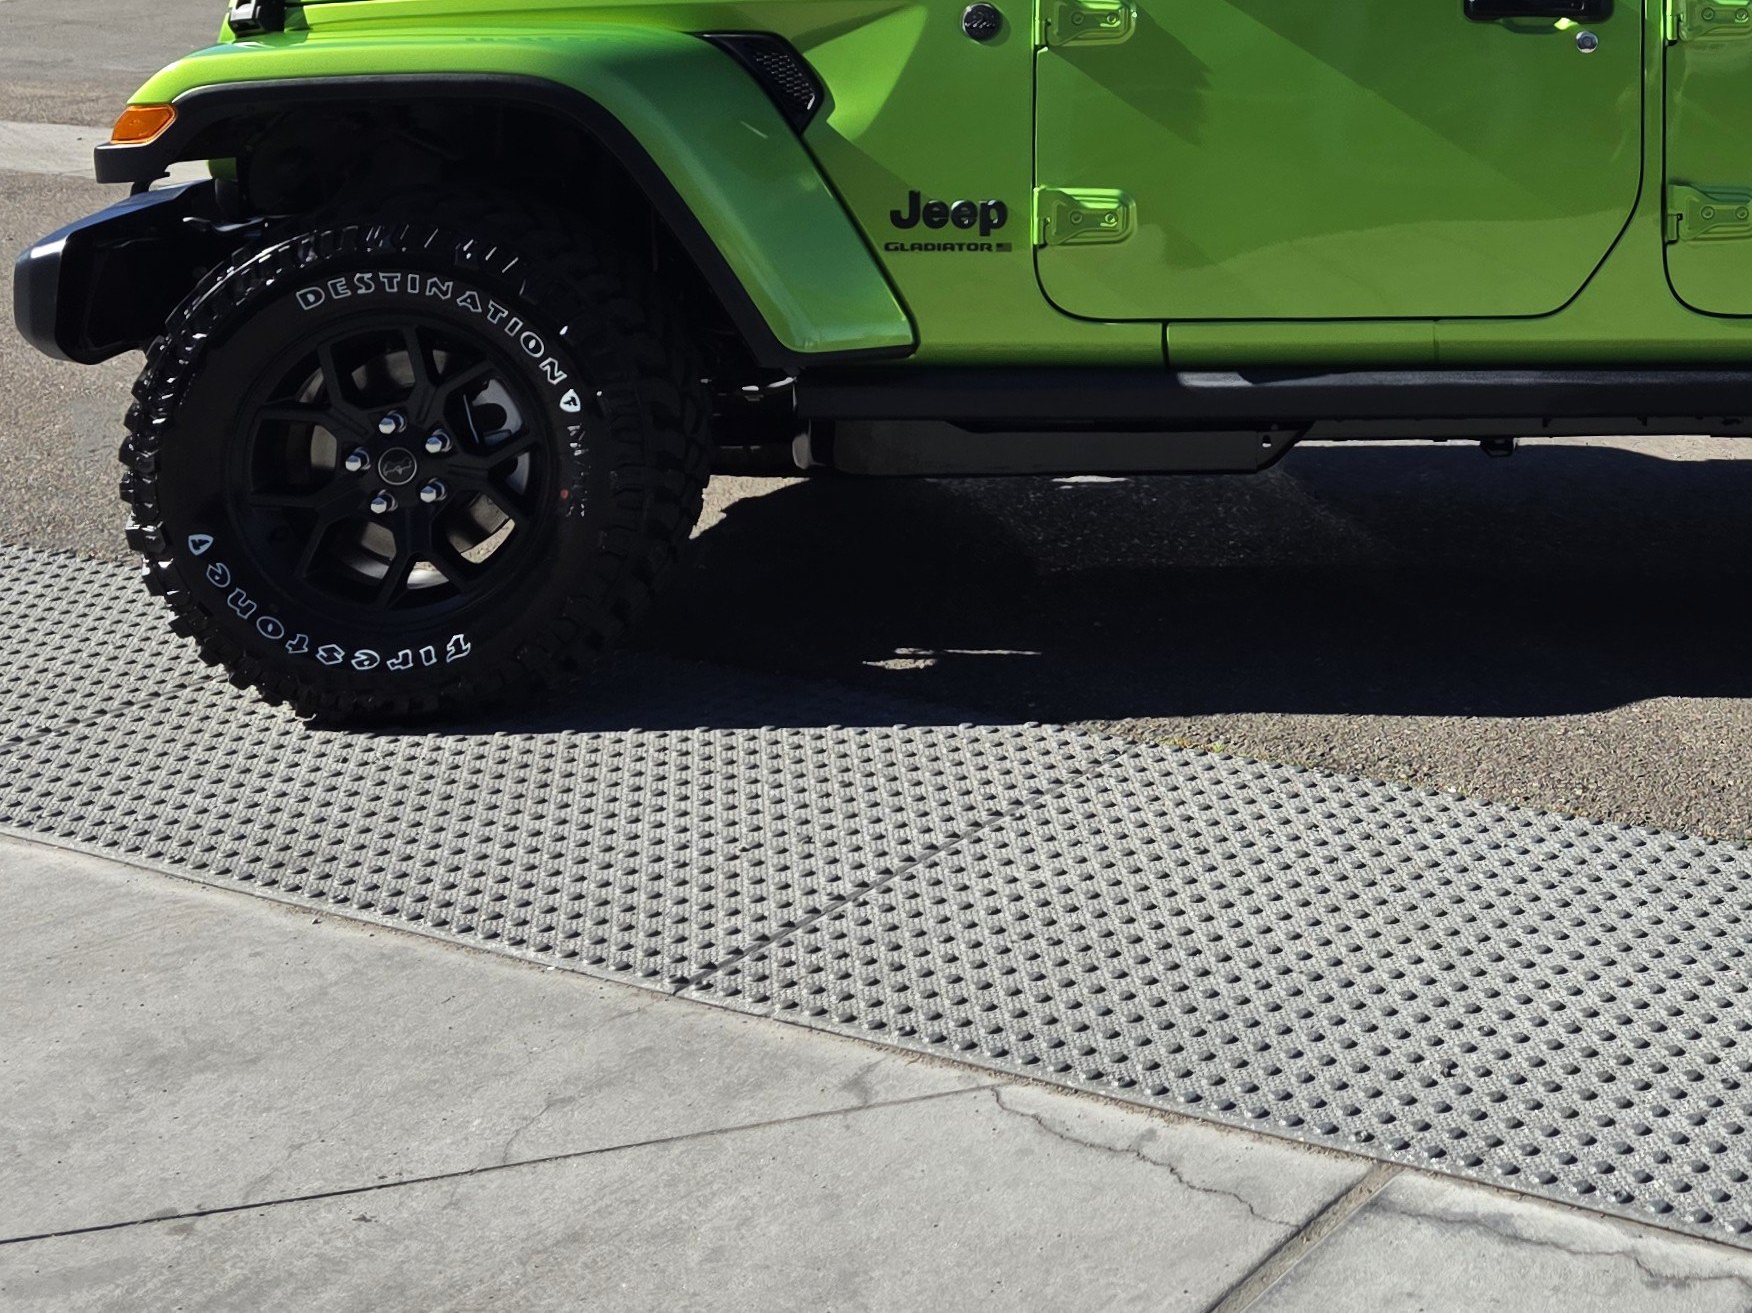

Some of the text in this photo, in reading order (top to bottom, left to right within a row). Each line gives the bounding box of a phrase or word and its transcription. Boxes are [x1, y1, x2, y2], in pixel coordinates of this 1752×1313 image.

[890, 190, 1008, 236] Jeep
[884, 242, 993, 252] GLADIATOR
[296, 272, 567, 385] DESTINATION
